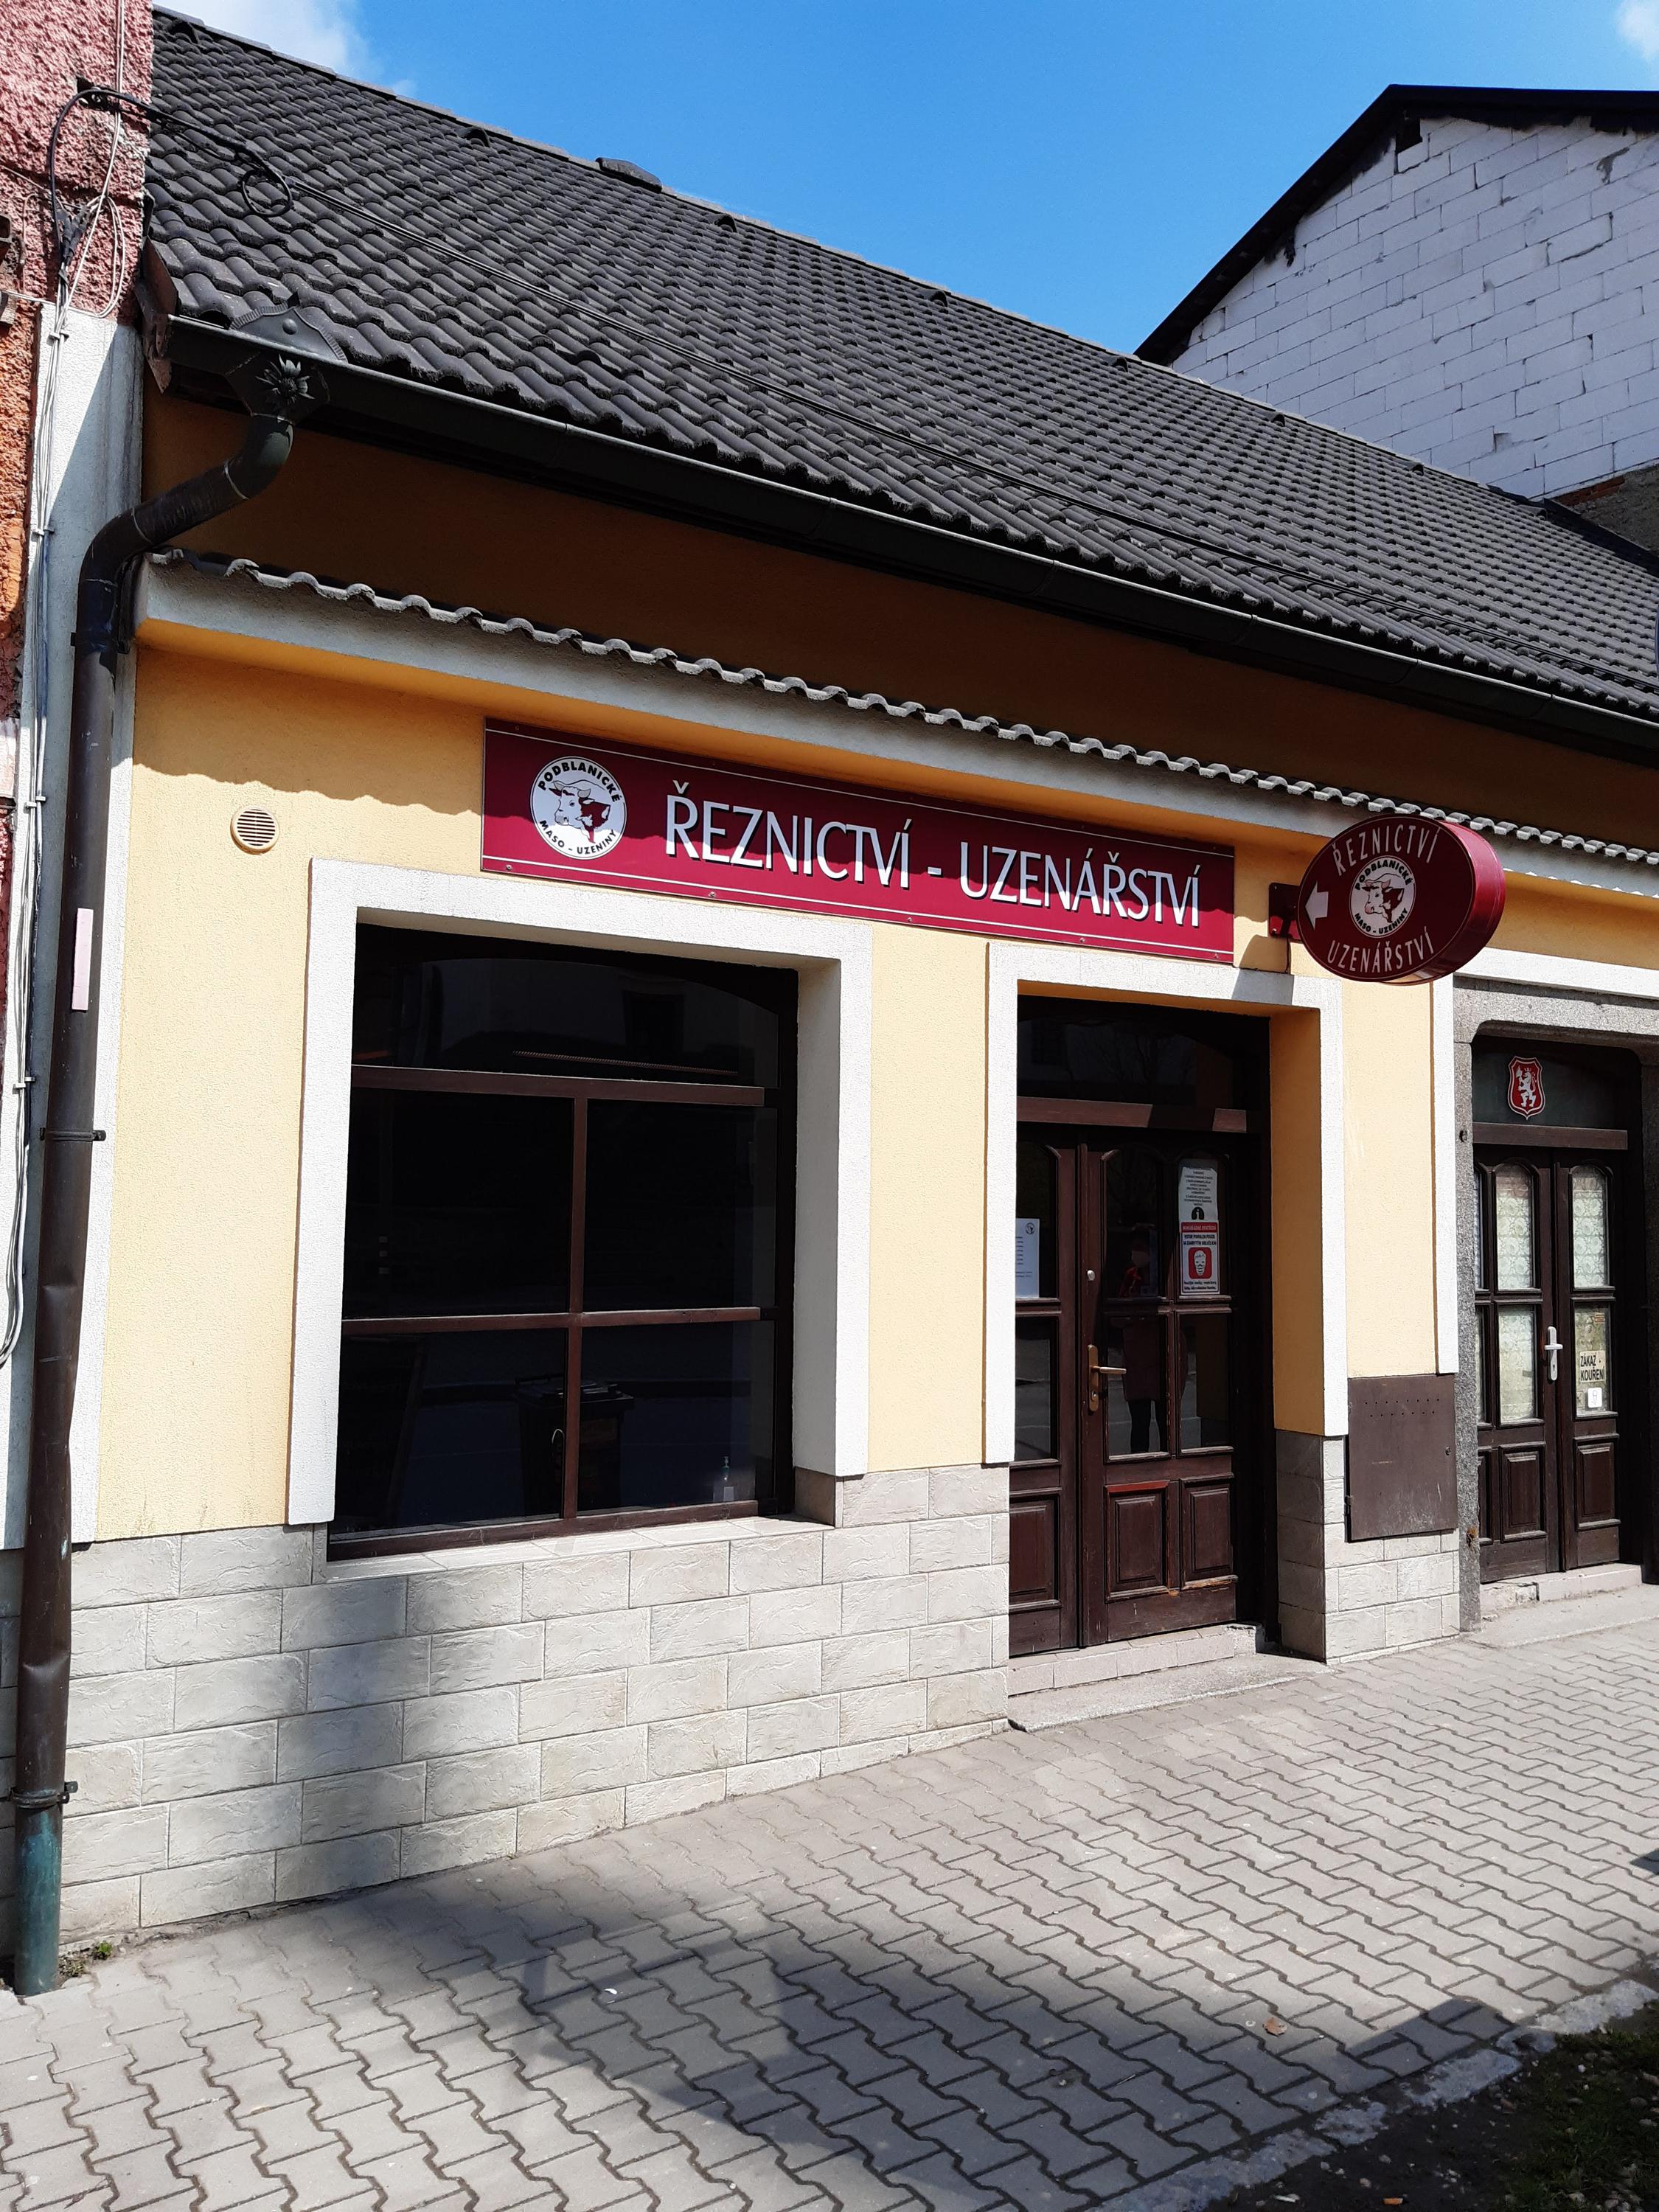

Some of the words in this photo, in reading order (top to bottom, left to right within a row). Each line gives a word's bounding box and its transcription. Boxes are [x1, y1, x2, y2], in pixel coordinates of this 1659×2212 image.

[538, 761, 622, 803] PODBLANICKÉ
[539, 820, 566, 848] MASO
[577, 829, 616, 855] UZENINY
[666, 779, 912, 889] ŘEZNICTVÍ
[927, 866, 942, 876] -
[960, 841, 1200, 928] UZENÁŘSTVÍ
[1331, 824, 1441, 877] ŘEZNICTVÍ
[1354, 859, 1413, 891] PODBLANICKÉ
[1354, 913, 1371, 932] MASO
[1378, 908, 1408, 934] UZENINY
[1326, 926, 1435, 974] UZENÁŘSTVÍ
[1580, 1353, 1596, 1367] ZÁKAZ
[1580, 1366, 1605, 1381] KOUŘENÍ
